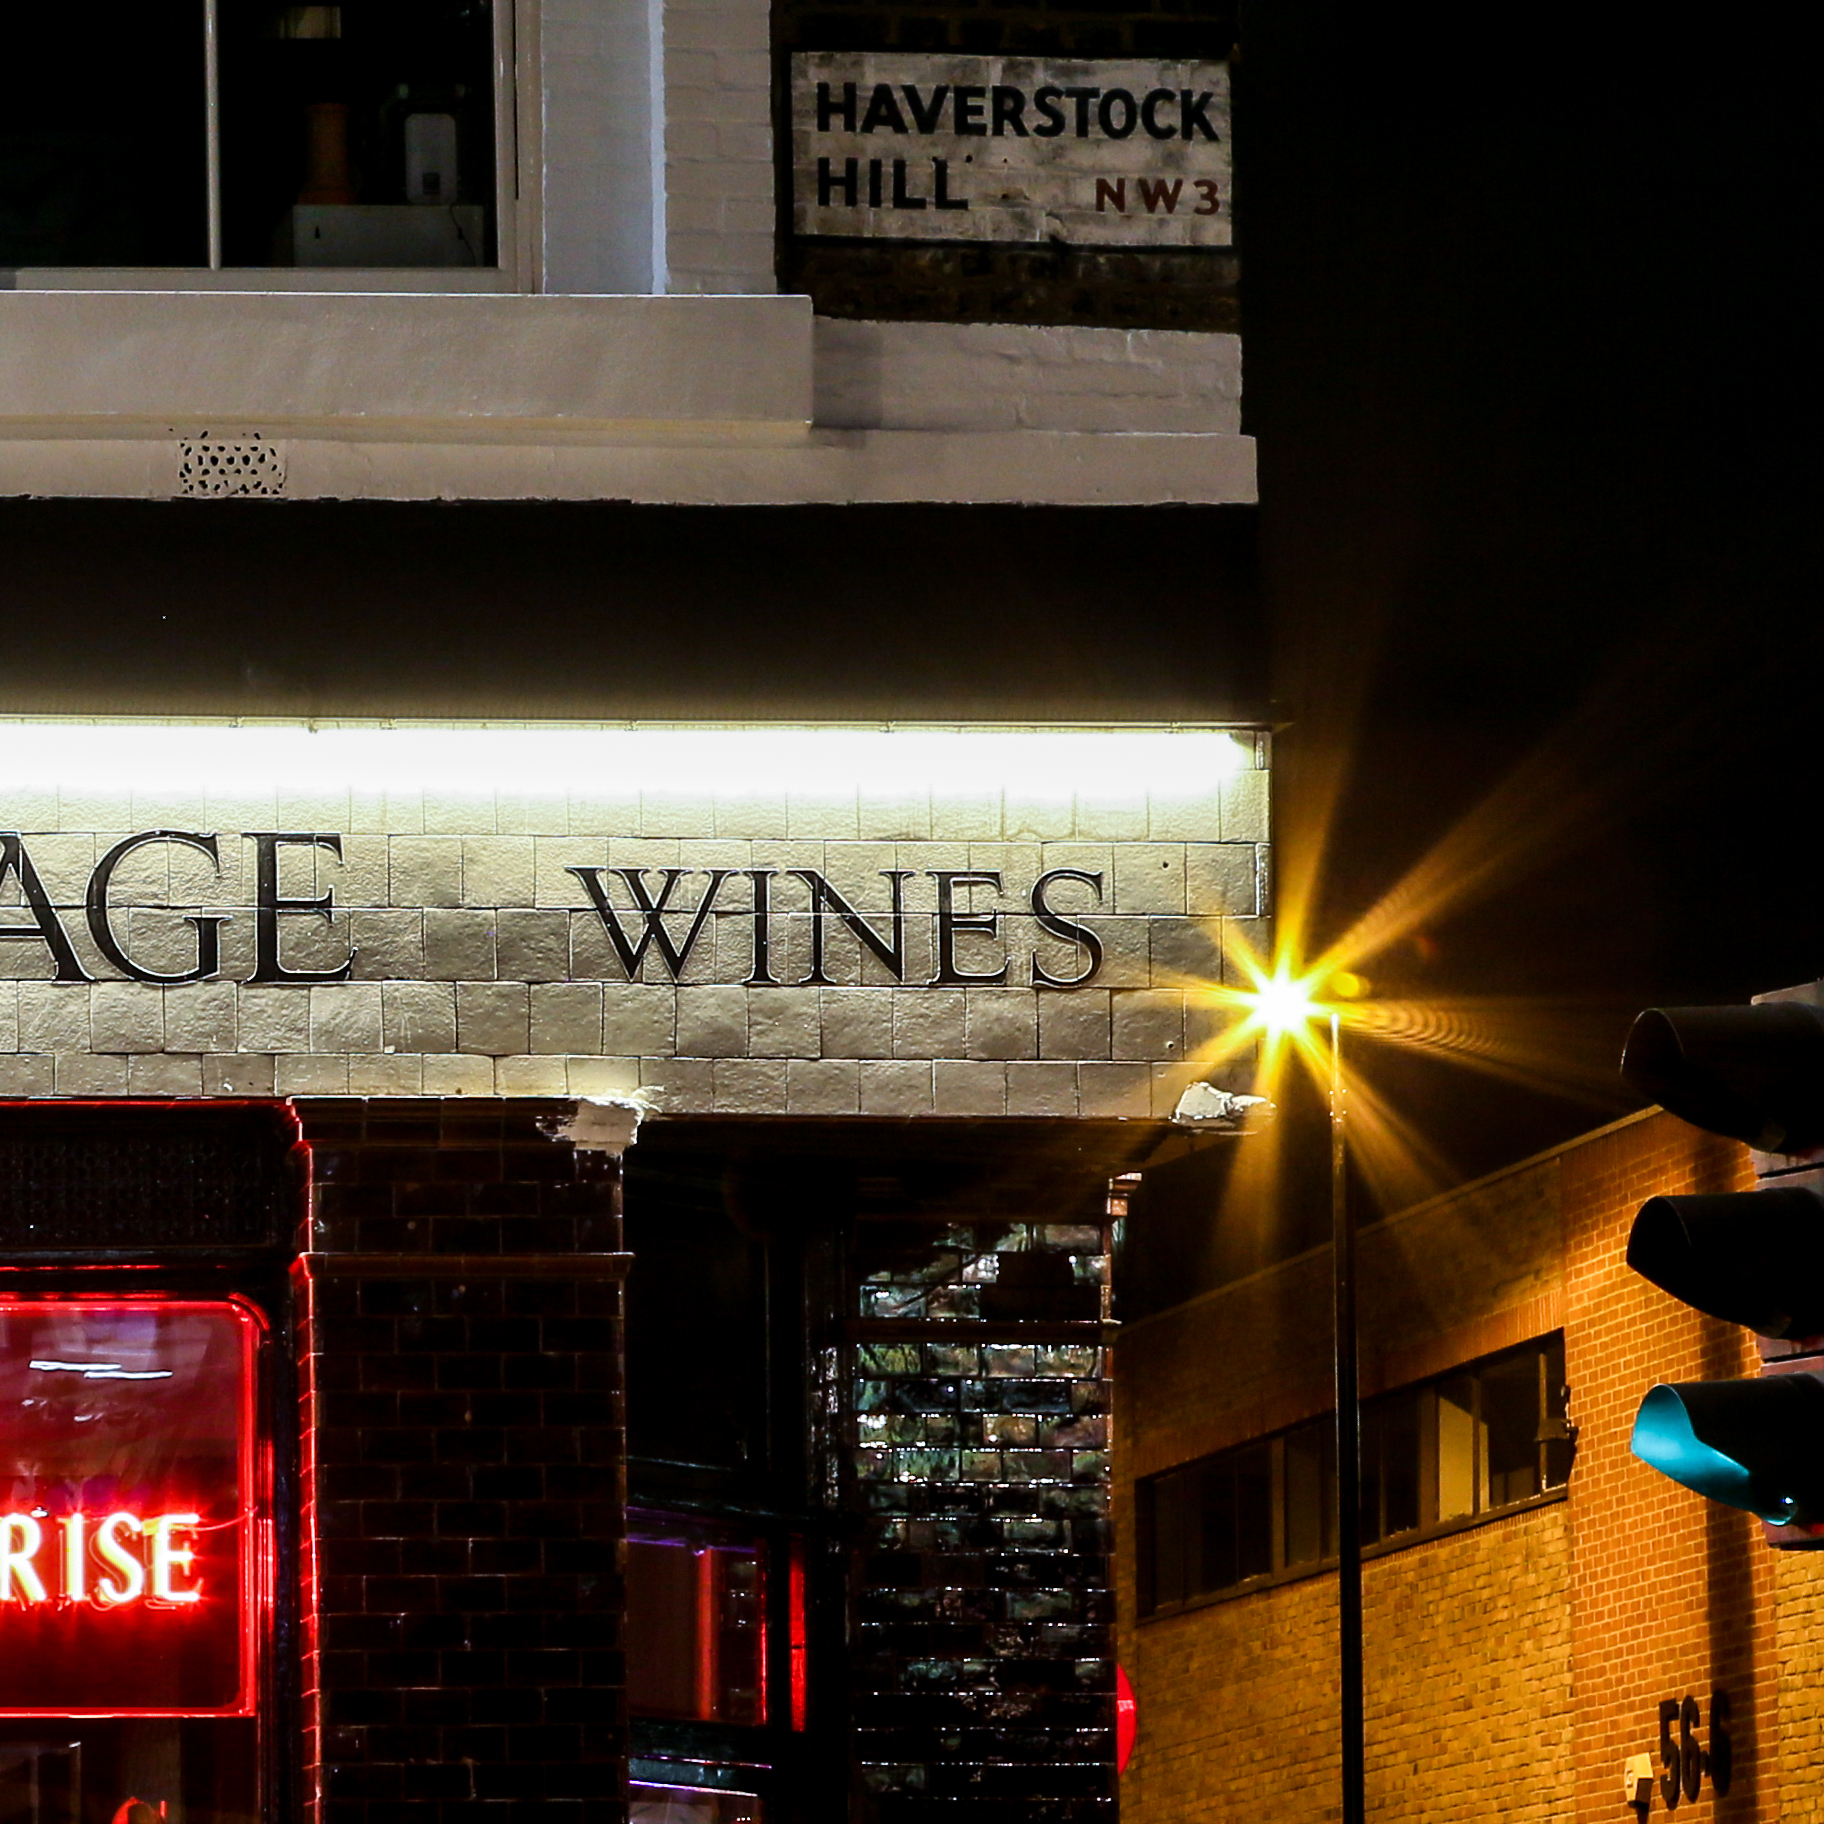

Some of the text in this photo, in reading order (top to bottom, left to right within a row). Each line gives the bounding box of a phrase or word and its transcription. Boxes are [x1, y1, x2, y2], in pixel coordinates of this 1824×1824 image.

[816, 82, 1220, 142] HAVERSTOCK
[816, 156, 969, 211] HILL
[1094, 177, 1221, 216] NW3
[564, 866, 1104, 990] WINES
